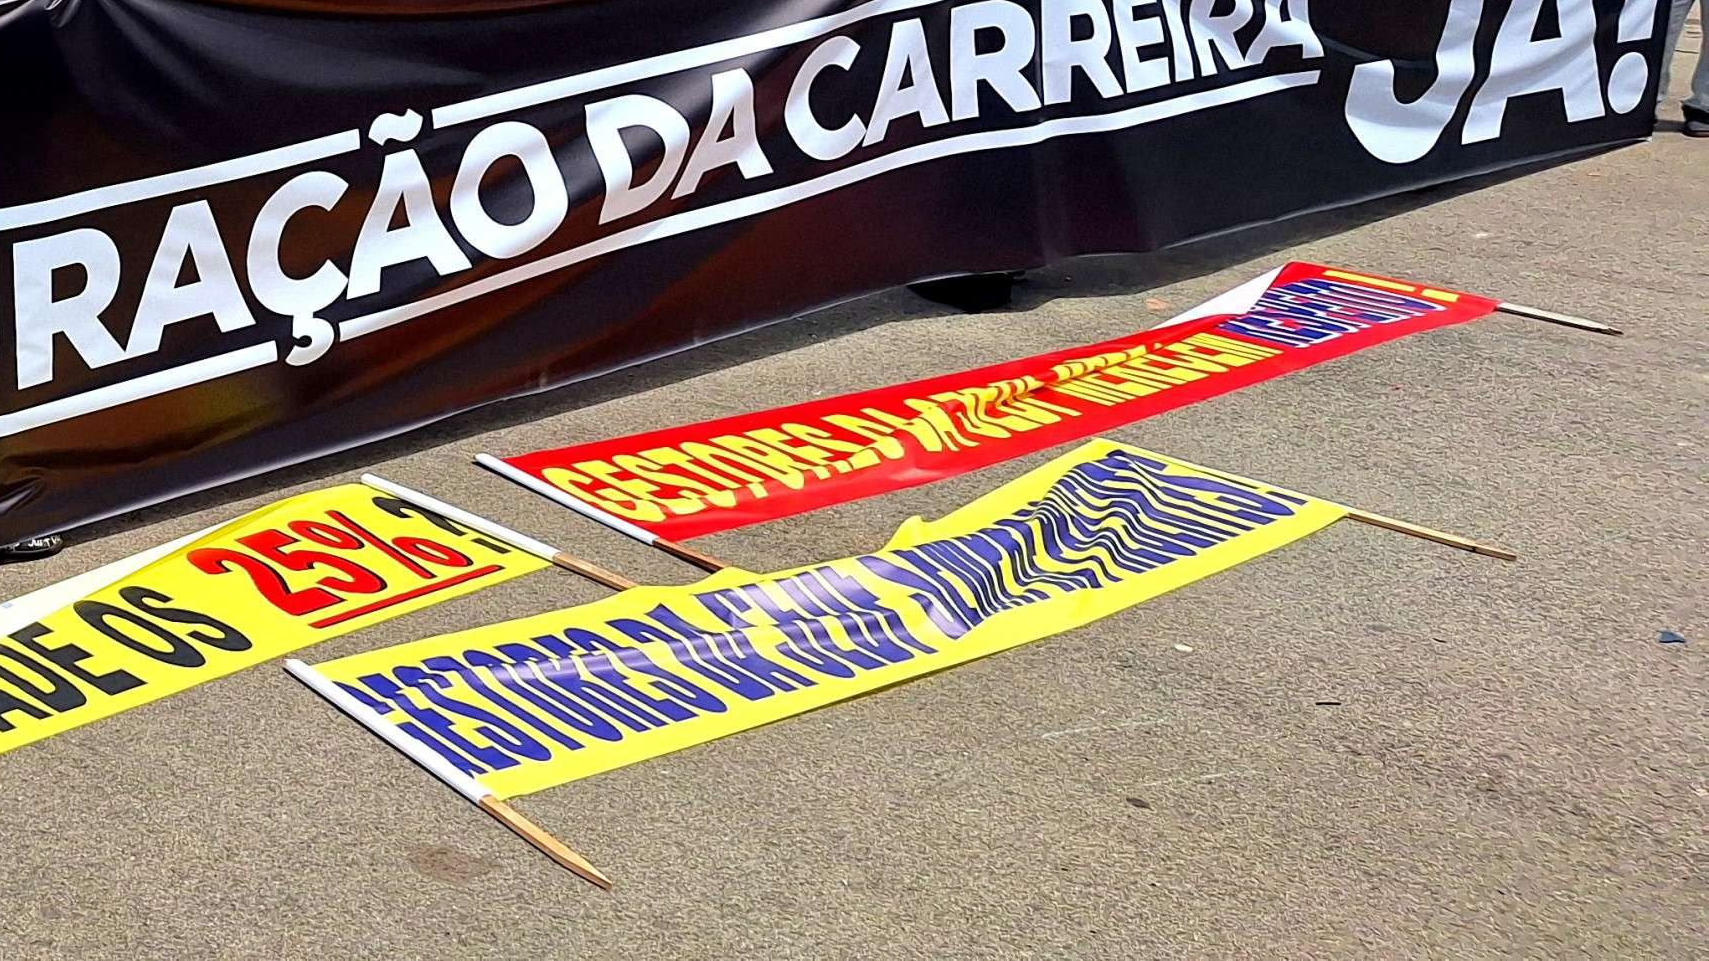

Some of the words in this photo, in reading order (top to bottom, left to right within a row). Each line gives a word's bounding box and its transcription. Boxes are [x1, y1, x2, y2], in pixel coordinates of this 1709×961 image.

[585, 67, 774, 225] DA
[541, 423, 904, 523] GESTORES
[73, 584, 254, 668] OS
